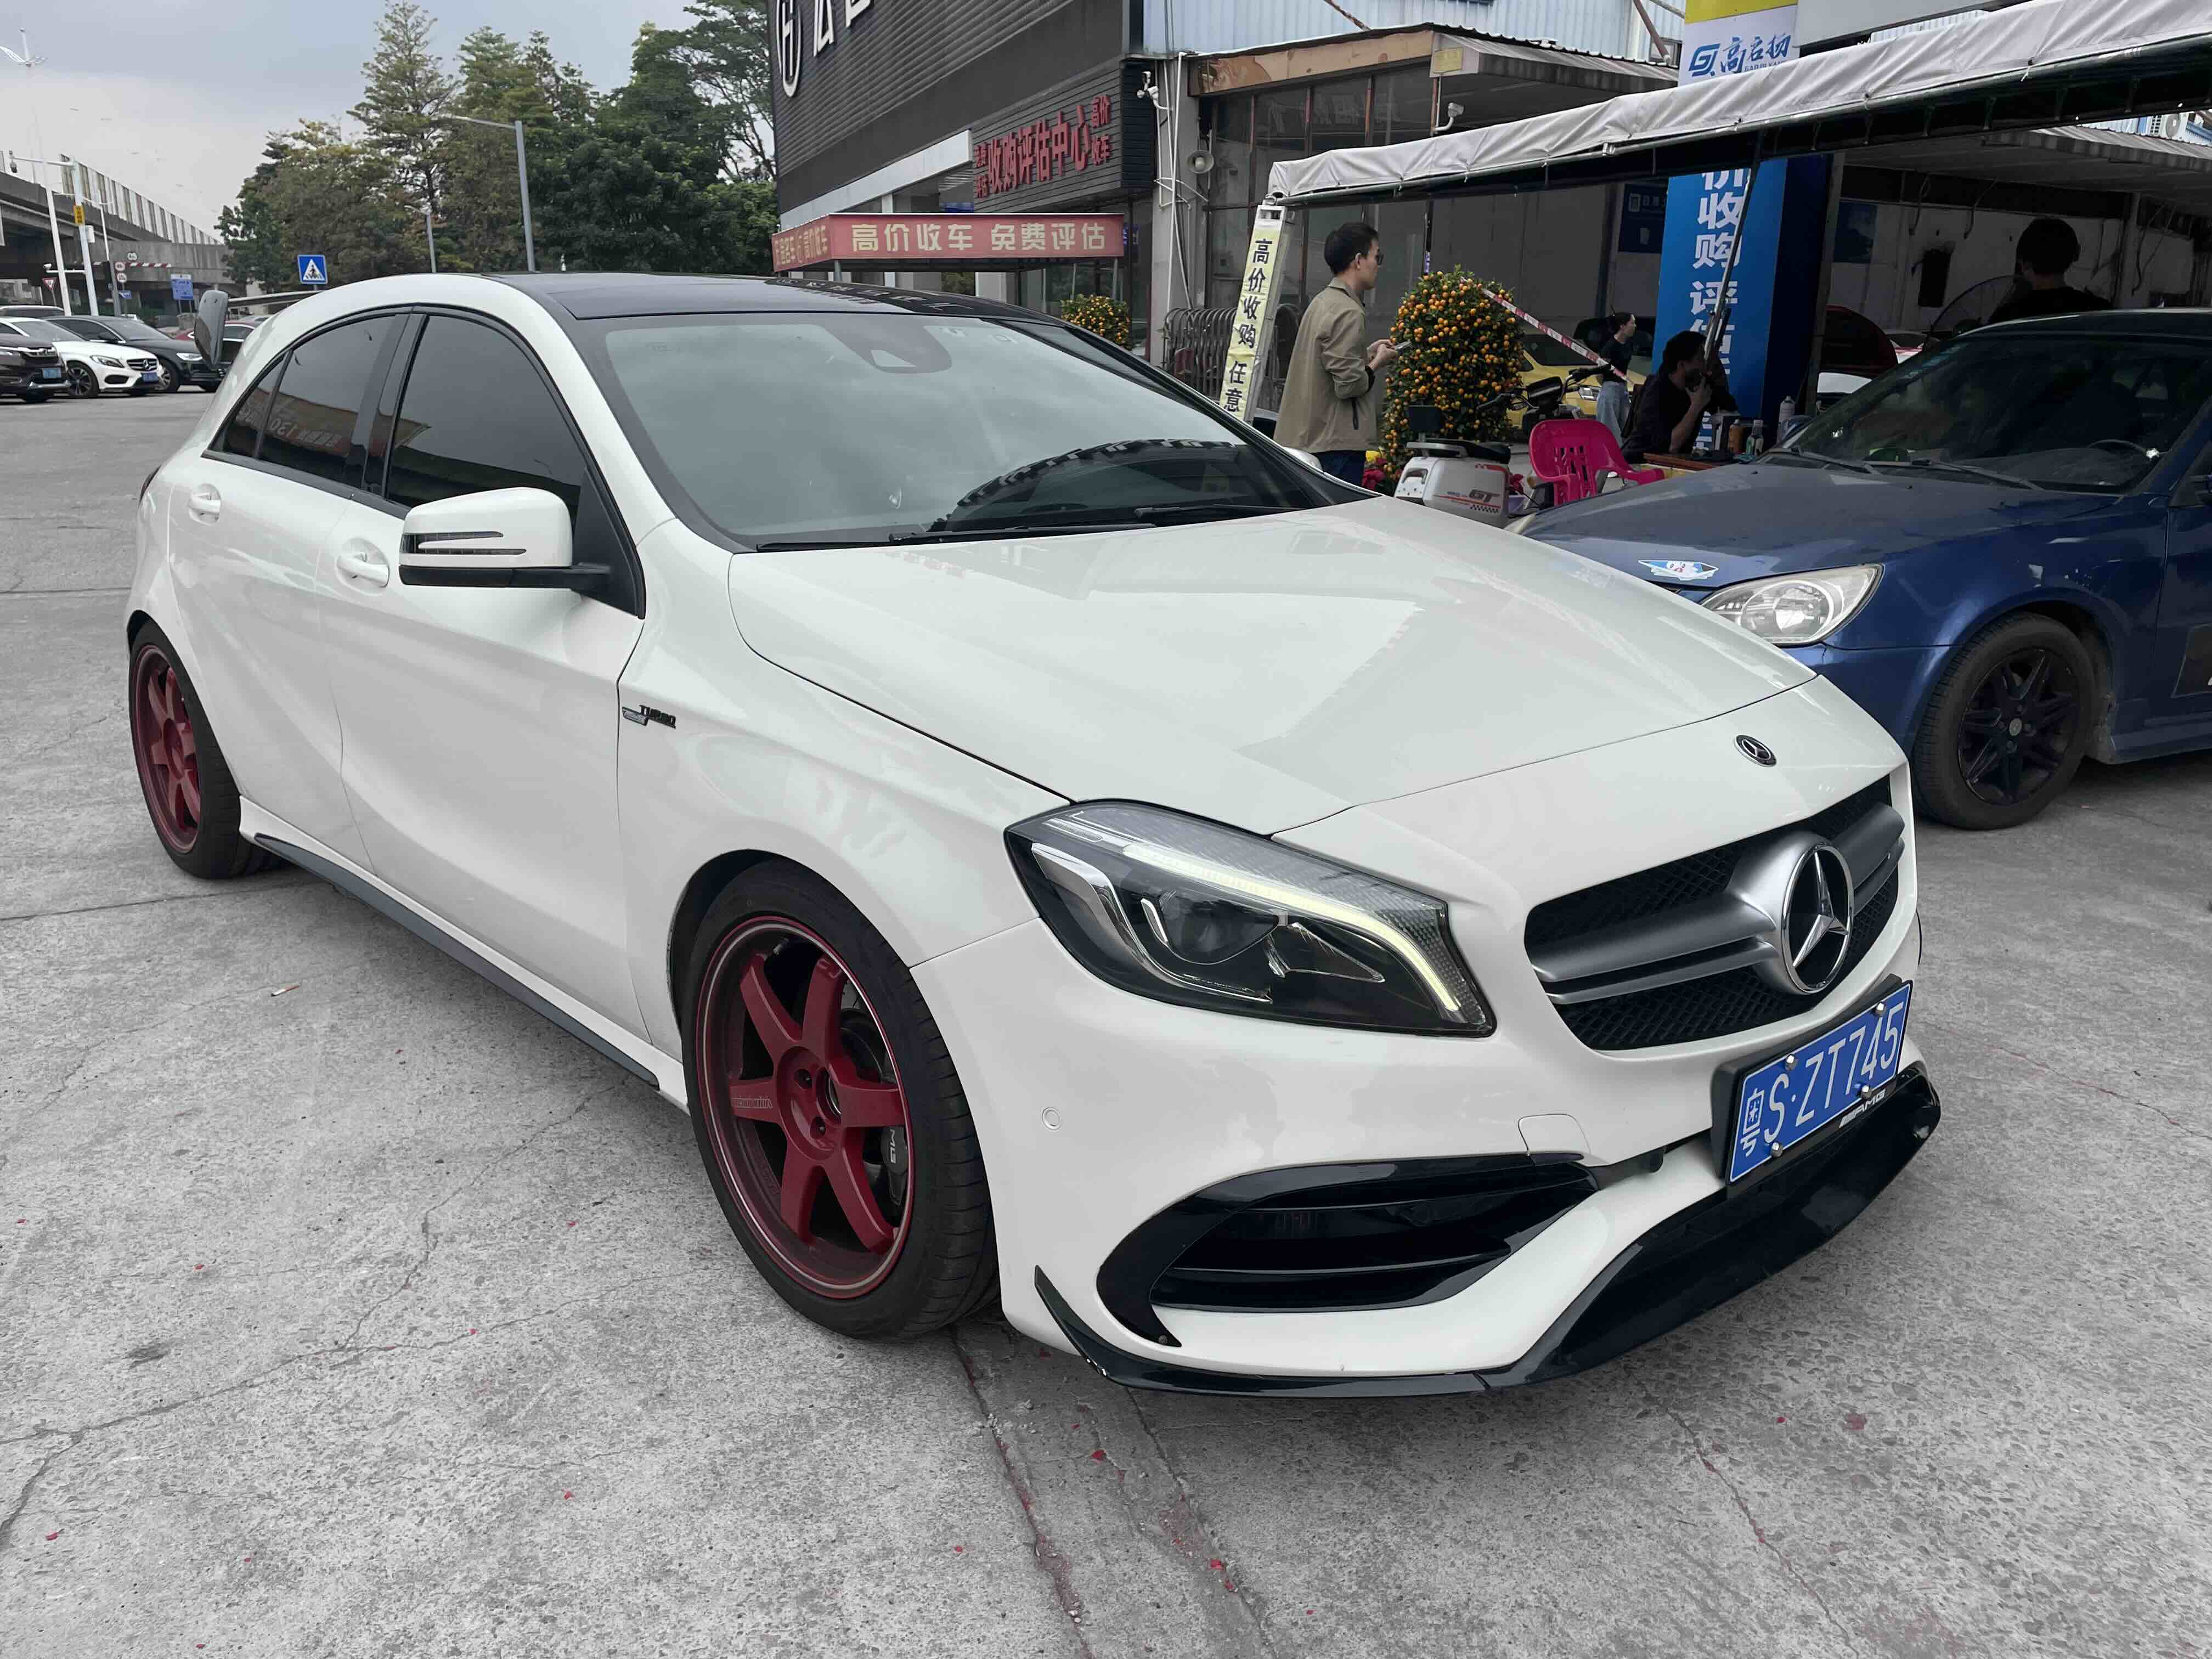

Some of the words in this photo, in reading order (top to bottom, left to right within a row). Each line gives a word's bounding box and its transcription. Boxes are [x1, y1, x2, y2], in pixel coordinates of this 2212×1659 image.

[989, 105, 1090, 193] 收购评估中心
[851, 223, 973, 252] 高价收车
[991, 223, 1105, 251] 免费评估
[1238, 238, 1273, 349] 高价收购
[1469, 489, 1500, 503] GT
